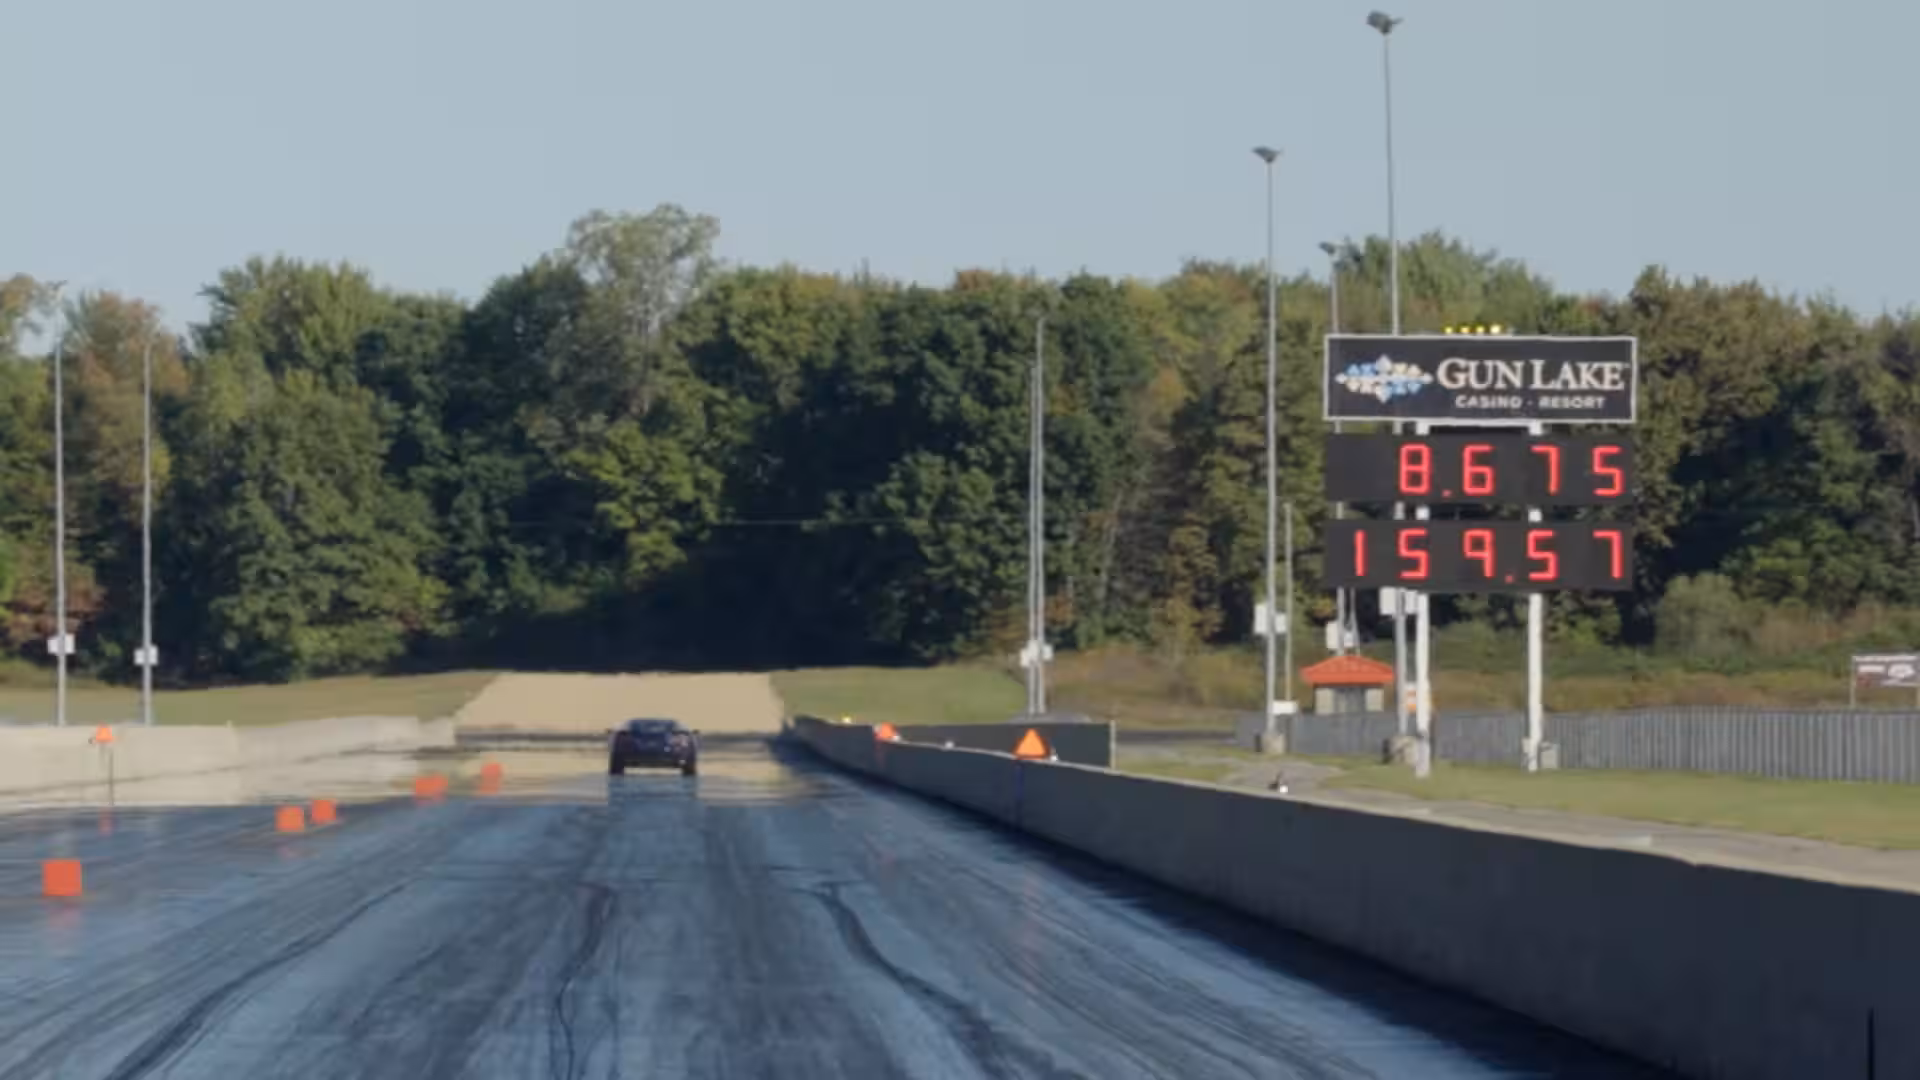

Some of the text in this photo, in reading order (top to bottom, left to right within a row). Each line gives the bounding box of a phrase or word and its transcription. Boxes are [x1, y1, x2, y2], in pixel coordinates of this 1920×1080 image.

[1437, 357, 1625, 391] GUN LAKE
[1455, 395, 1606, 409] CASINO RESORT
